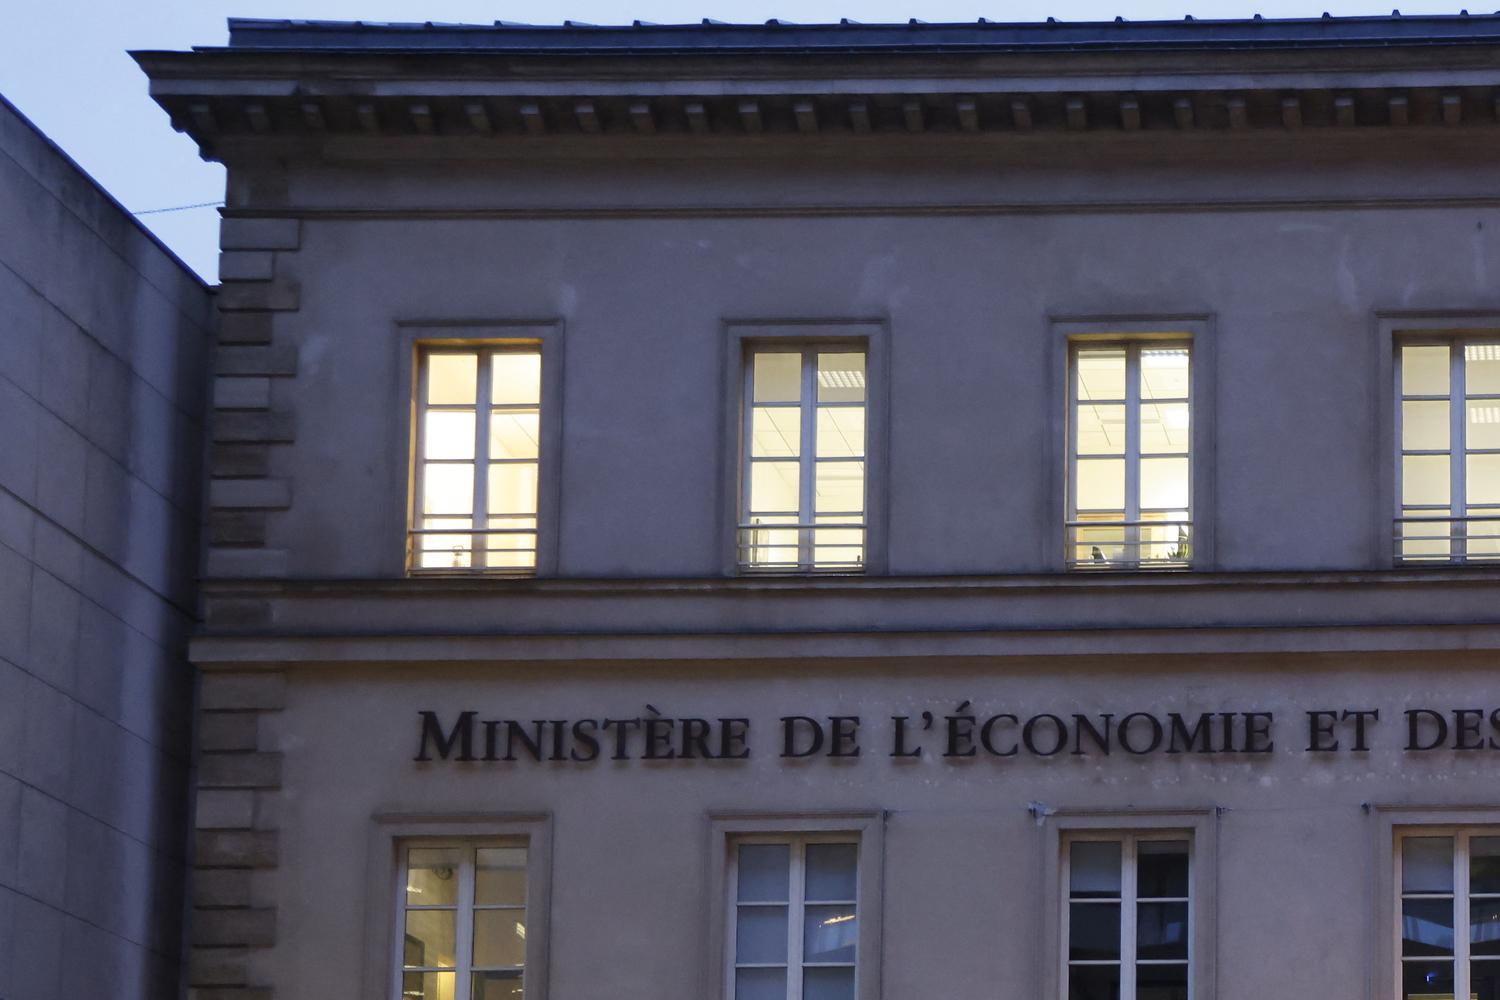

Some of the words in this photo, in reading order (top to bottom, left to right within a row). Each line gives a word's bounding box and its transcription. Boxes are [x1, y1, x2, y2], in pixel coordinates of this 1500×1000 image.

[413, 703, 751, 762] MINISTÈRE
[779, 715, 860, 758] DE
[889, 700, 1275, 758] L'ÉCONOMIE
[1304, 708, 1379, 752] ET
